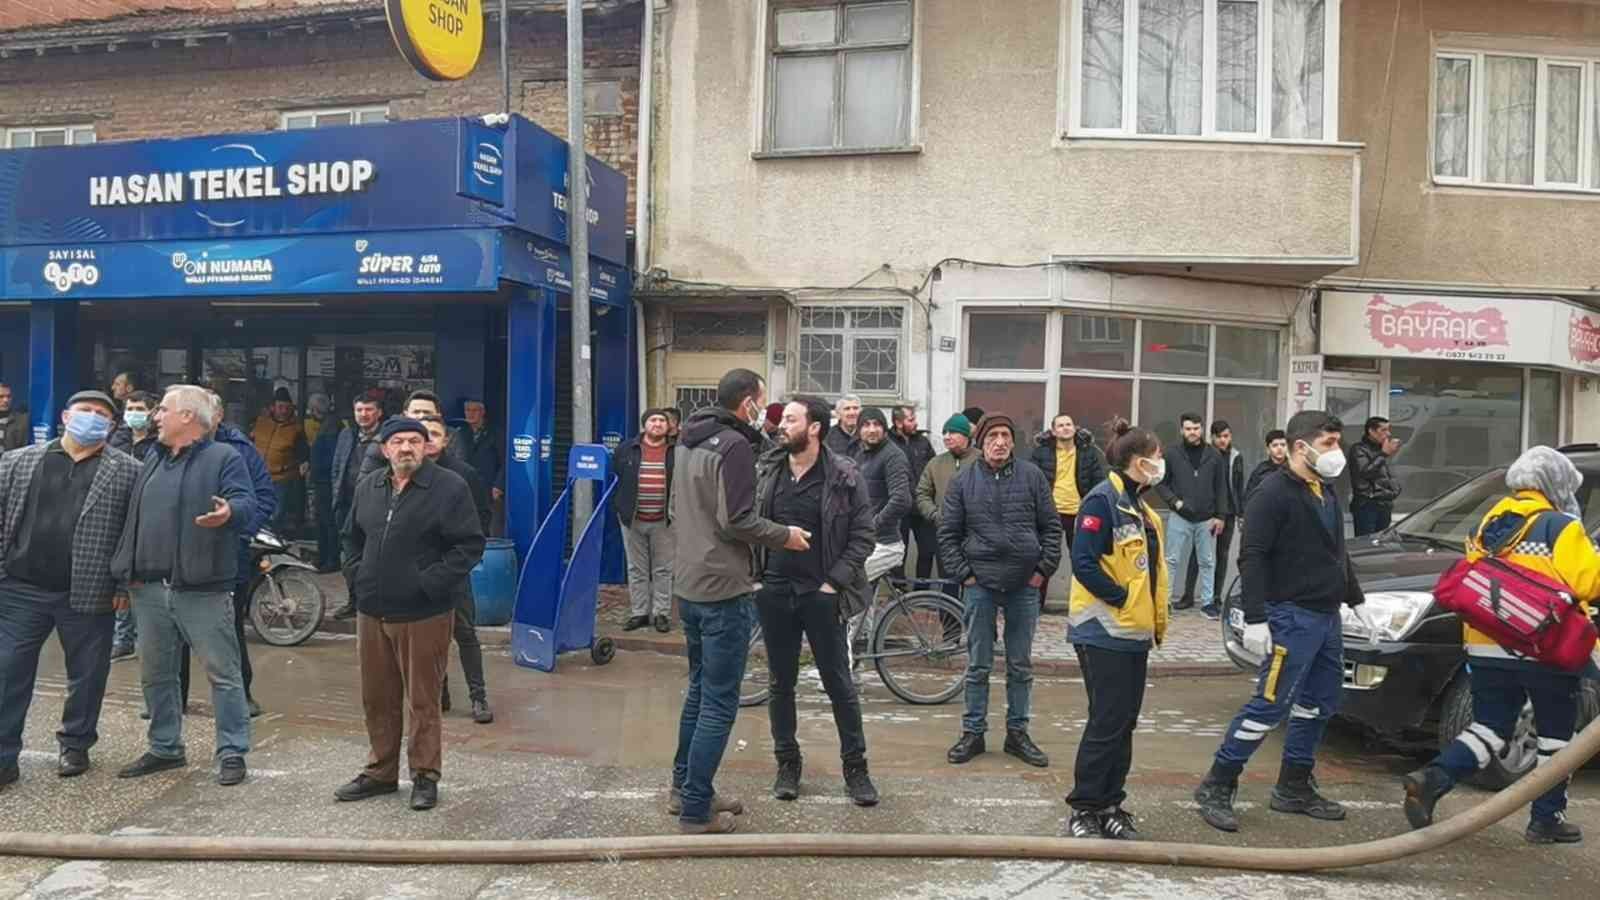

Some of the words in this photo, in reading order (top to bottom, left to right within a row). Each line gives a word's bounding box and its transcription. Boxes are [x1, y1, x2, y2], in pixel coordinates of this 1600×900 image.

[428, 3, 464, 37] SHOP
[89, 171, 183, 206] HASAN
[190, 166, 281, 200] TEKEL
[287, 160, 373, 194] SHOP
[49, 249, 96, 260] SAYISAL
[359, 252, 414, 273] SÜPER
[210, 258, 273, 274] NUMARA
[418, 263, 442, 274] LOTO
[45, 263, 97, 291] LOTO
